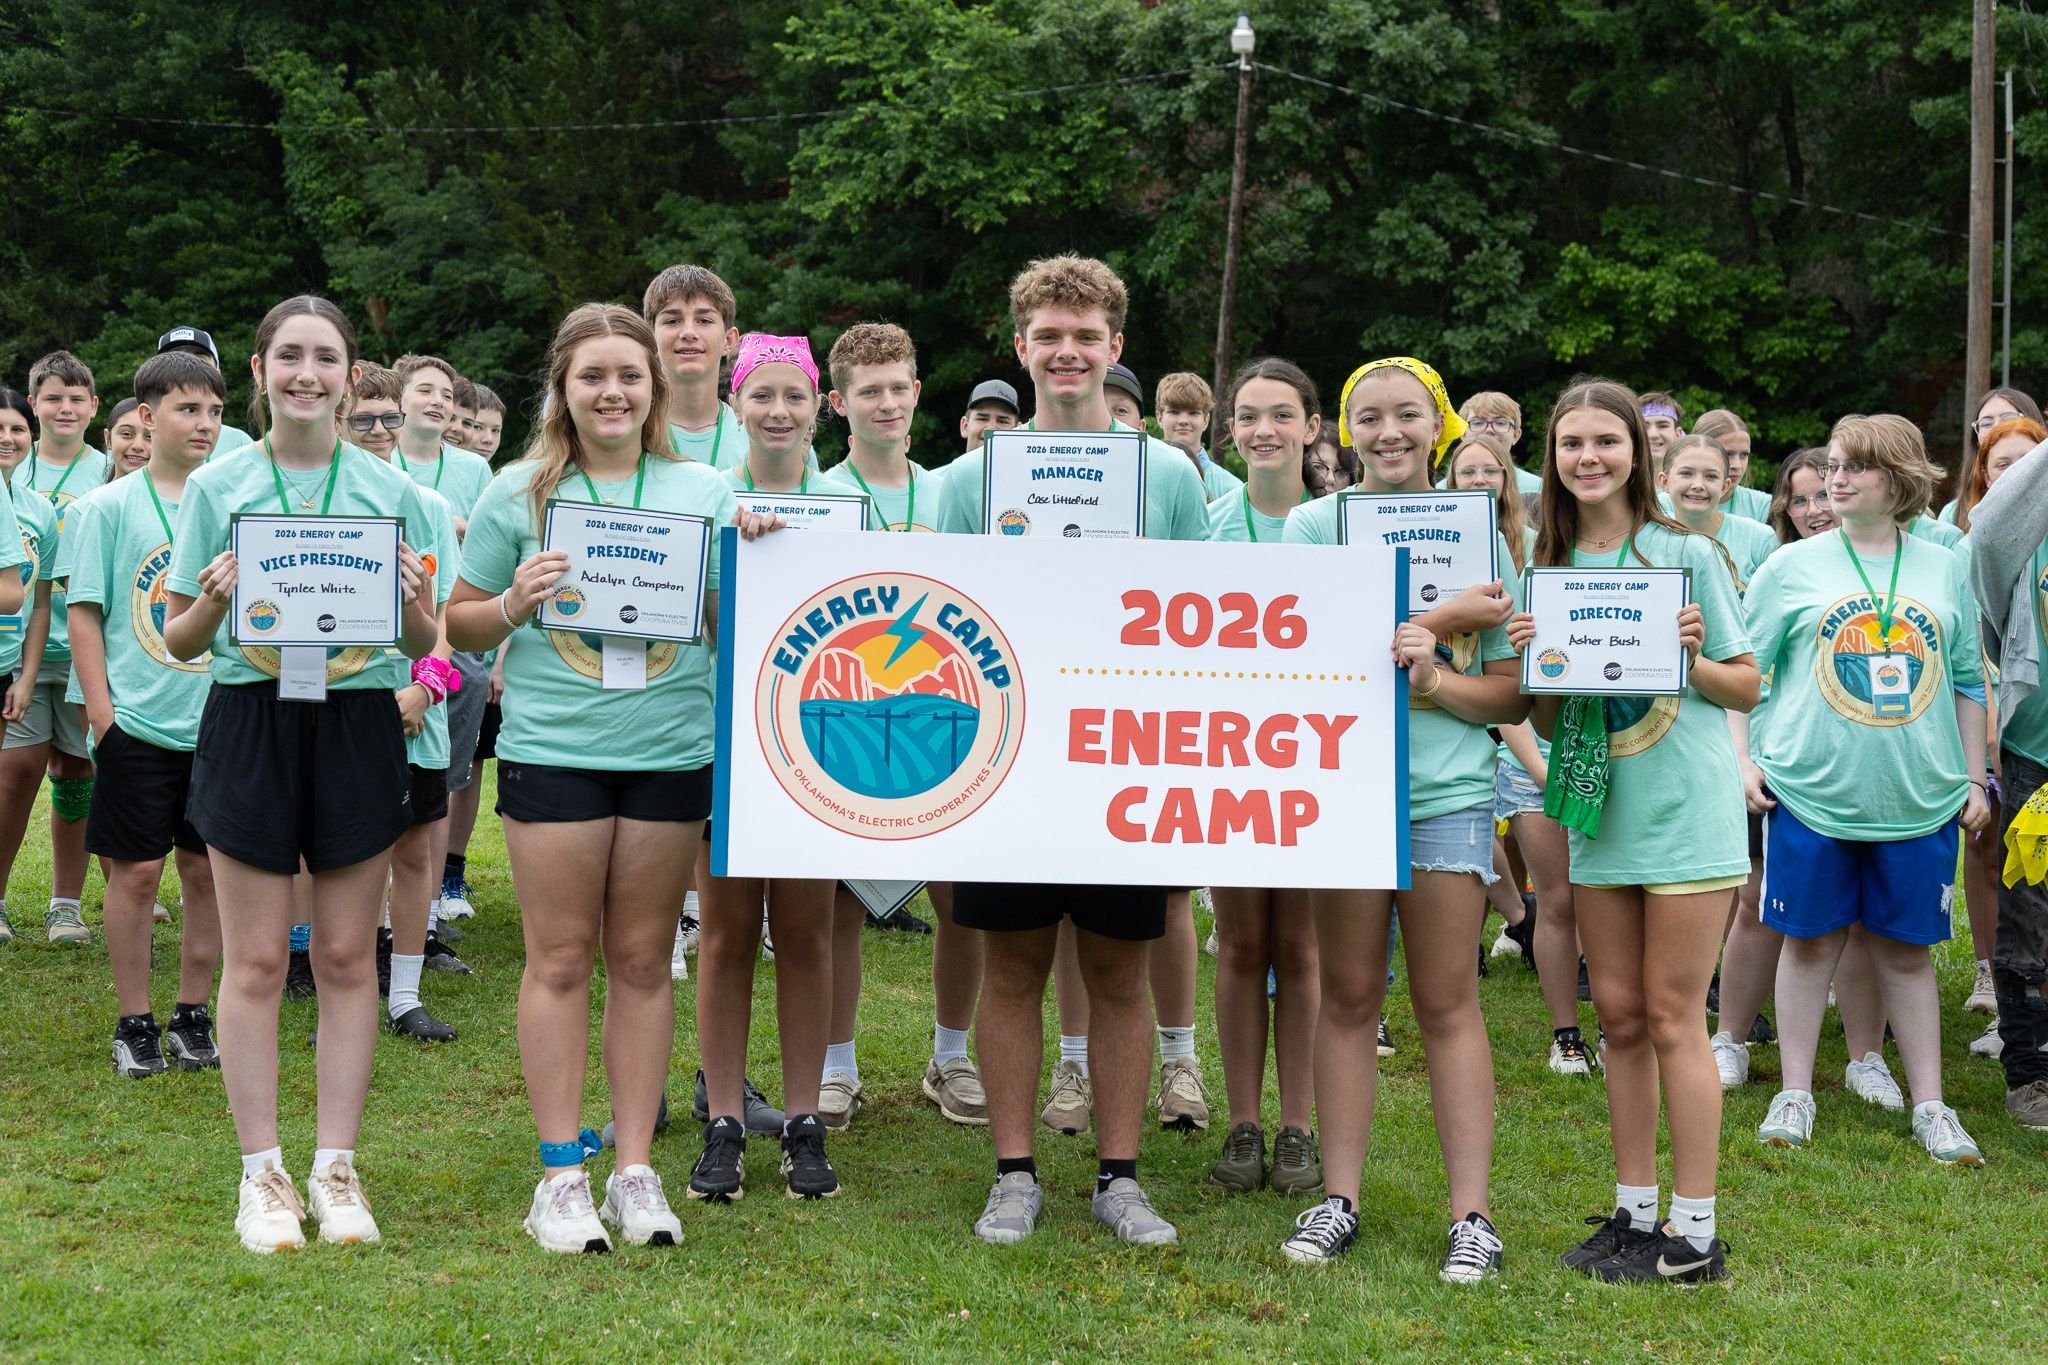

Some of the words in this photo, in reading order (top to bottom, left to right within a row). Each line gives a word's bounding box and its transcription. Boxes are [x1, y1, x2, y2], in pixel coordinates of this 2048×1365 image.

[1027, 446, 1047, 454] 2026
[1050, 446, 1082, 455] ENERGY
[1086, 447, 1109, 456] CAMP
[1031, 466, 1104, 483] MANAGER
[774, 507, 805, 515] ENERGY
[808, 508, 831, 516] CAMP
[1377, 506, 1397, 514] 2026
[1400, 505, 1432, 513] ENERGY
[1435, 504, 1458, 513] CAMP
[275, 529, 297, 538] 2026
[300, 530, 335, 539] ENERGY
[339, 531, 364, 540] CAMP
[586, 519, 607, 529] 2026
[610, 522, 644, 533] ENERGY
[646, 526, 671, 536] CAMP
[1382, 528, 1461, 546] TREASURER
[259, 554, 297, 573] VICE
[300, 553, 383, 575] PRESIDENT
[587, 545, 668, 566] PRESIDENT
[136, 549, 171, 592] ENER
[581, 570, 626, 587] Adalyn
[632, 576, 684, 591] Compston
[272, 582, 316, 597] Tynlee
[321, 582, 356, 594] White
[1564, 582, 1585, 591] 2026
[1588, 582, 1622, 591] ENERGY
[1625, 582, 1649, 591] CAMP
[1121, 589, 1308, 650] 2026
[1569, 607, 1643, 622] DIRECTOR
[772, 585, 900, 676] ENERGY
[936, 602, 1012, 689] CAMP
[1904, 606, 1938, 653] CAMP
[1568, 634, 1603, 646] Asher
[1609, 635, 1640, 647] Bush
[564, 638, 597, 670] OKLAHOMA'S
[1630, 707, 1669, 747] COOPERATIVES
[1068, 708, 1359, 770] ENERGY
[794, 768, 856, 821] OKLAHOMA'S
[858, 813, 914, 827] ELECTRIC
[917, 767, 991, 823] COOPERATIVES
[1106, 786, 1320, 847] CAMP
